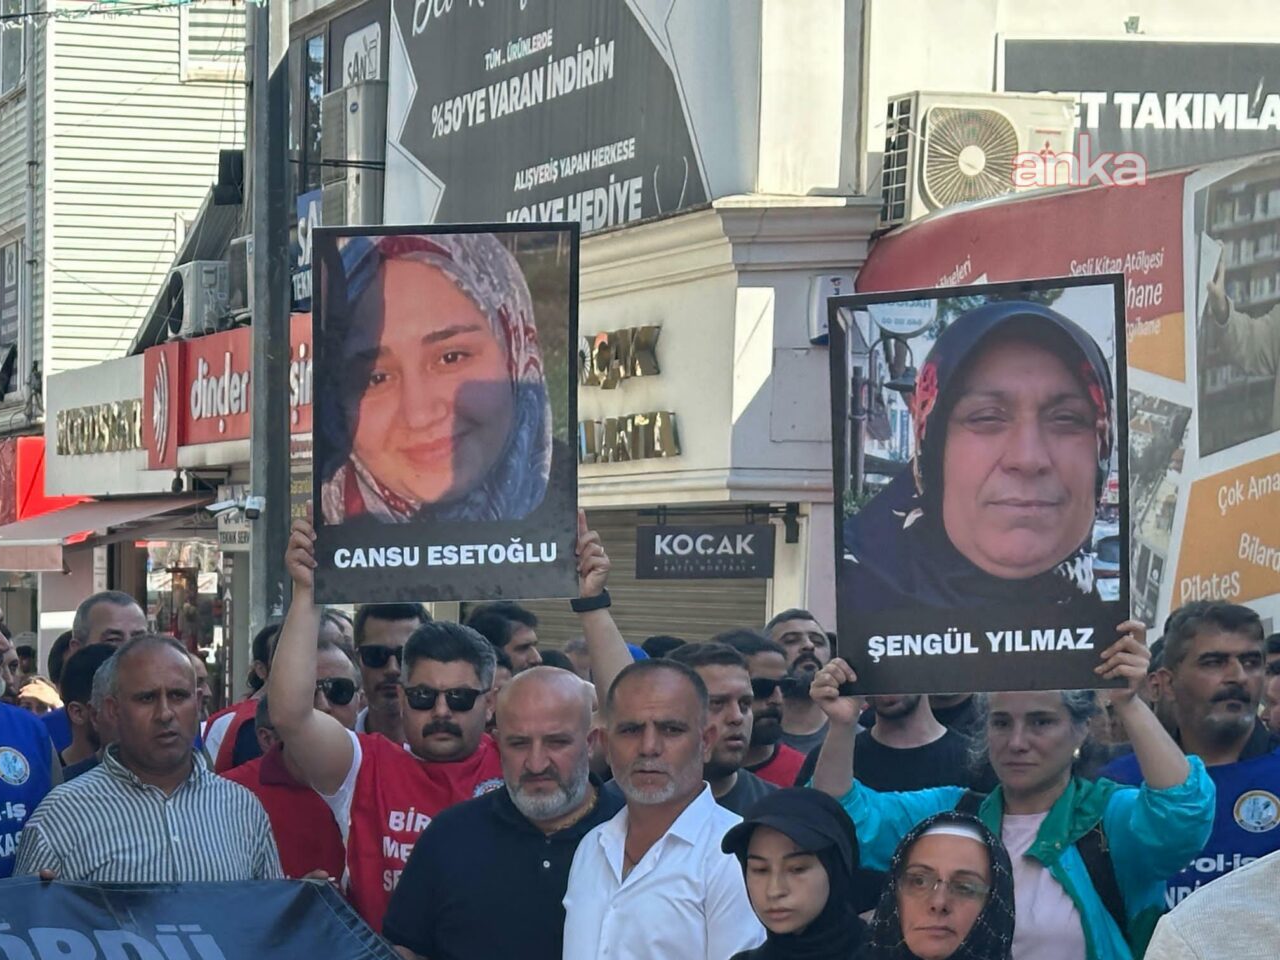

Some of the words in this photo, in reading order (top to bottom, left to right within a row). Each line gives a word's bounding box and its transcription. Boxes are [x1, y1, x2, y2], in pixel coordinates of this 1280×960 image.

[489, 66, 544, 120] VARAN
[546, 37, 615, 100] İNDİRİM
[514, 157, 559, 192] ALIŞVERİŞ
[560, 150, 591, 178] YAPAN
[591, 137, 636, 169] HERKESE
[567, 174, 643, 233] HEDİYE
[1218, 480, 1246, 516] Çok
[333, 546, 420, 569] CANSU
[427, 537, 558, 566] ESETOĞLU
[1180, 571, 1240, 605] Pilates
[868, 627, 979, 663] ŞENGÜL
[985, 627, 1095, 653] YILMAZ
